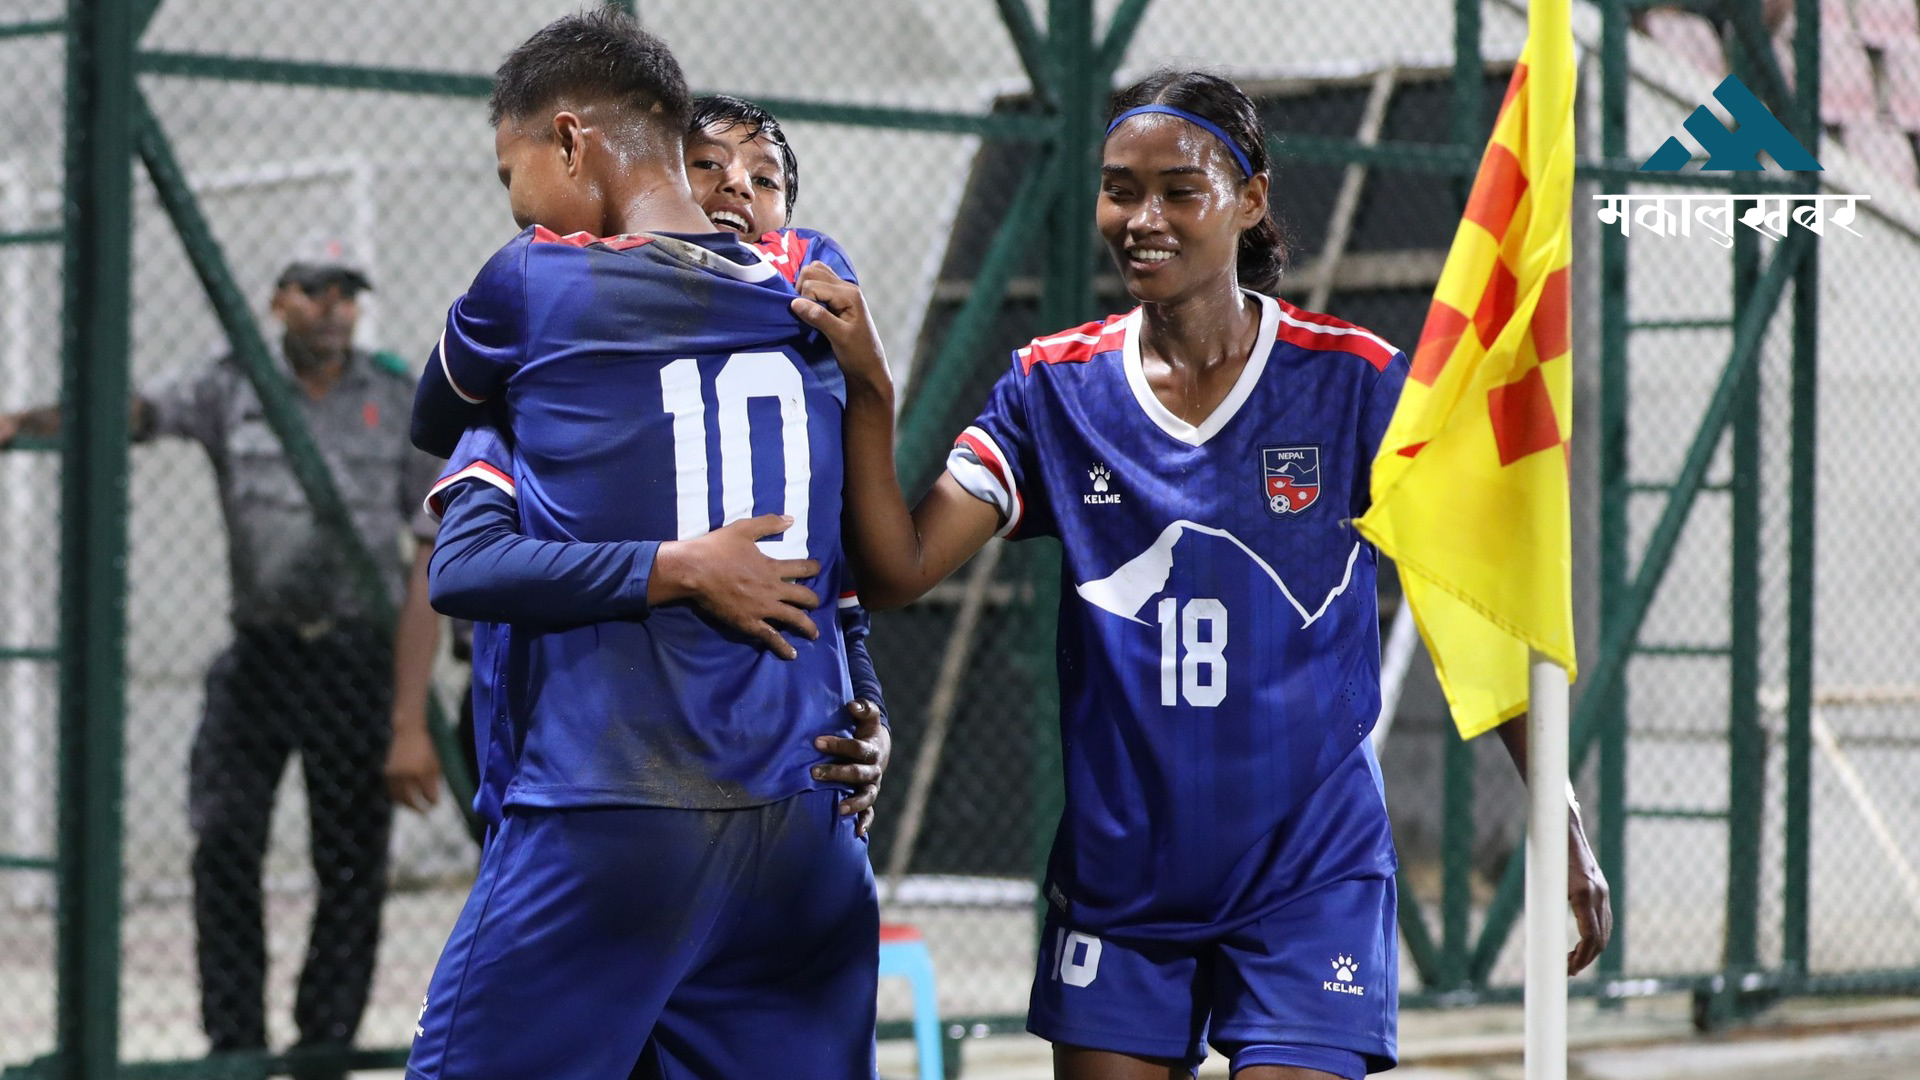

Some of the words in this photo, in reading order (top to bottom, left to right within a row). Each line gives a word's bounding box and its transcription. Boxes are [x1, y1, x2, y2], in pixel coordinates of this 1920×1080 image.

[660, 352, 811, 560] 10
[1278, 452, 1305, 460] NEPAL
[1084, 494, 1121, 504] KELME
[1158, 597, 1228, 707] 18
[1323, 981, 1364, 996] KELME
